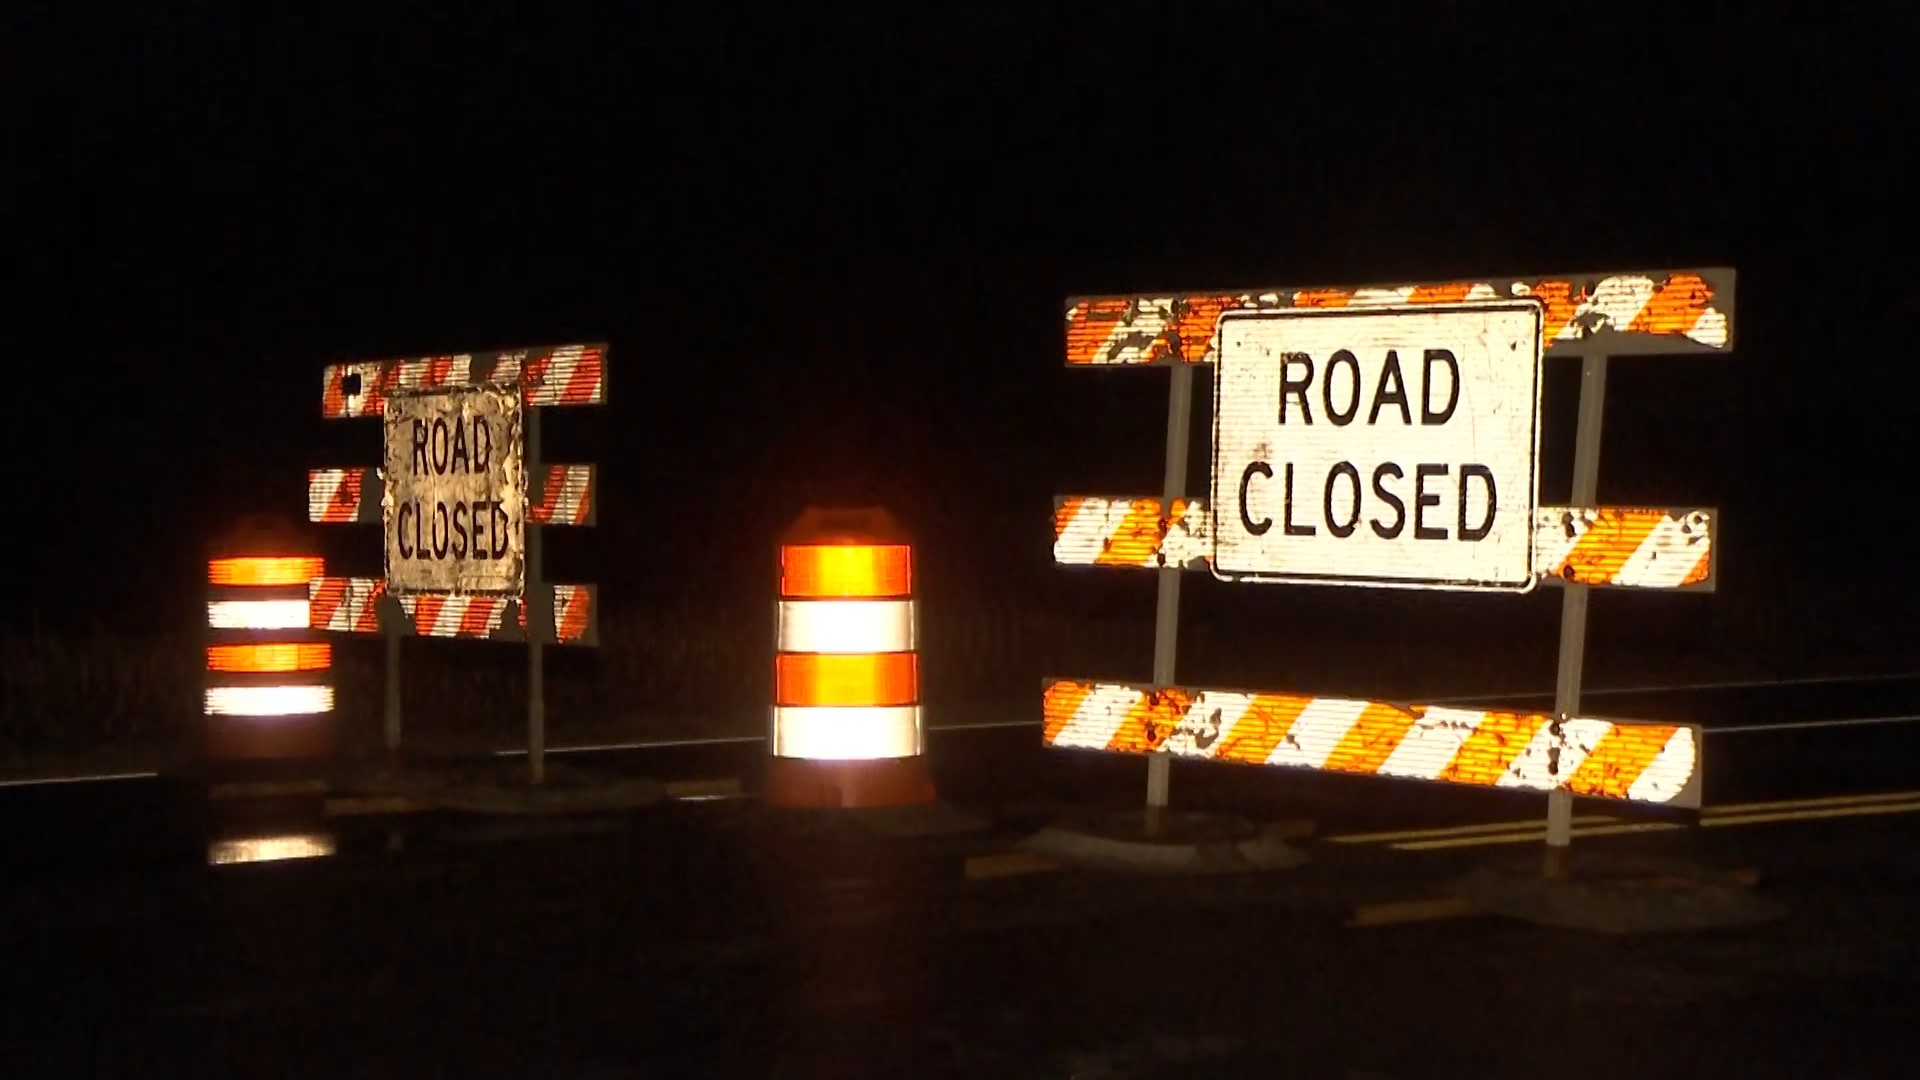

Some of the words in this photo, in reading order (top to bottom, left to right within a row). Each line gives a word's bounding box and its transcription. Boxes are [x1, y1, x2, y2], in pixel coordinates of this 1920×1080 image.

[1278, 349, 1460, 426] ROAD
[413, 415, 491, 476] ROAD
[398, 501, 509, 560] CLOSED
[1239, 461, 1497, 541] CLOSED
